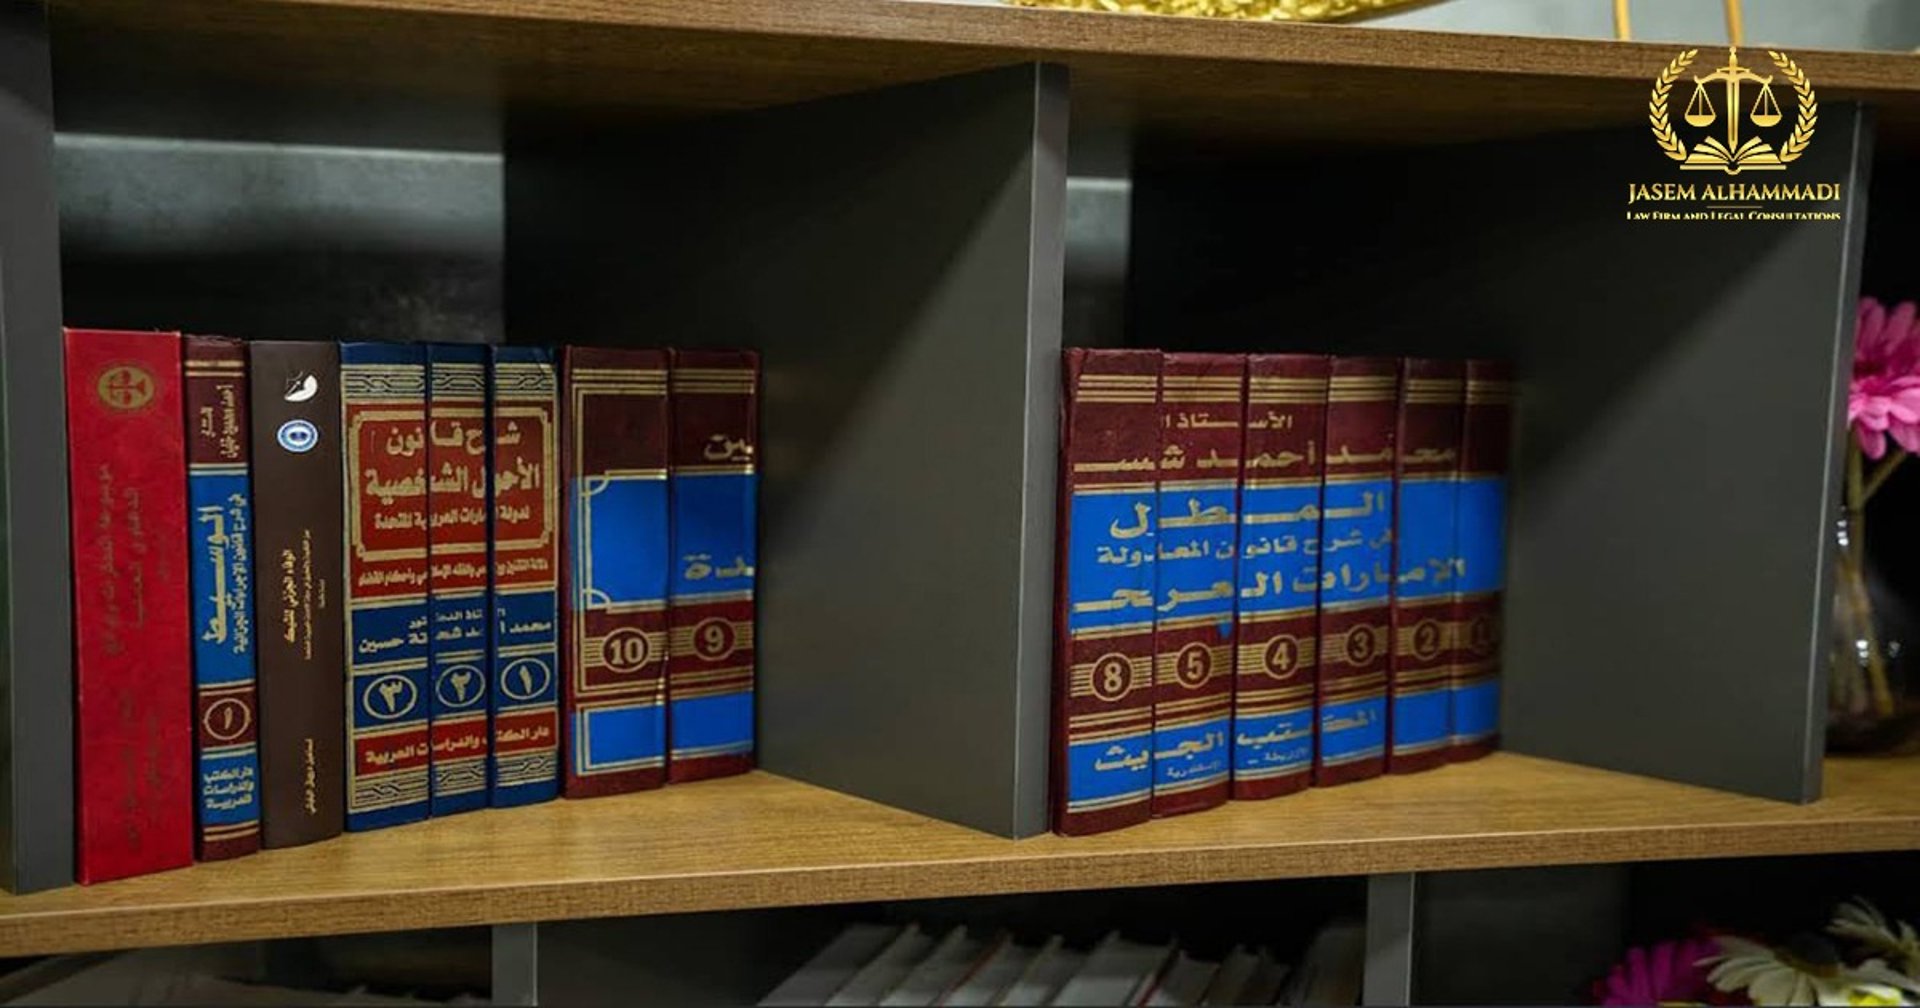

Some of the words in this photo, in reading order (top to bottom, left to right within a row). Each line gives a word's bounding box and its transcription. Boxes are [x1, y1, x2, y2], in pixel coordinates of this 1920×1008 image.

[197, 505, 233, 644] الوسيط
[610, 637, 645, 665] 10
[704, 624, 724, 653] 9
[1354, 632, 1370, 659] 3
[1420, 627, 1435, 653] 2
[1186, 651, 1204, 680] 5
[1272, 642, 1291, 671] 4
[450, 671, 472, 702] ٢
[1103, 661, 1122, 693] 8
[378, 680, 404, 713] ٣
